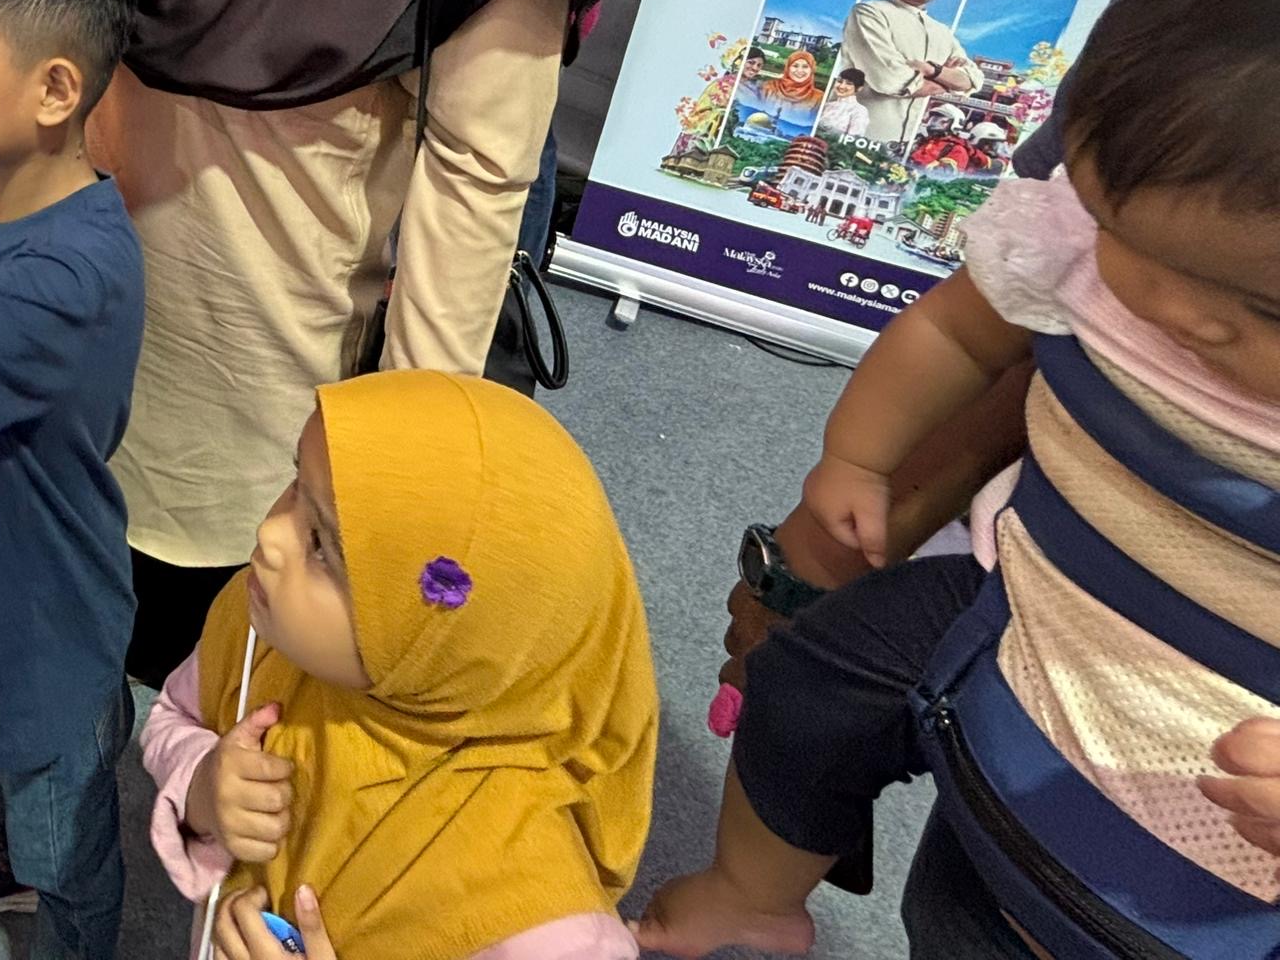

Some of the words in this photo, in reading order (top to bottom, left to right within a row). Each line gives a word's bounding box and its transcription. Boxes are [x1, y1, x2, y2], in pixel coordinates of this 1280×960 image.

[838, 134, 882, 151] IPOH
[638, 227, 699, 252] MADANI
[641, 218, 700, 242] MALAYSIA
